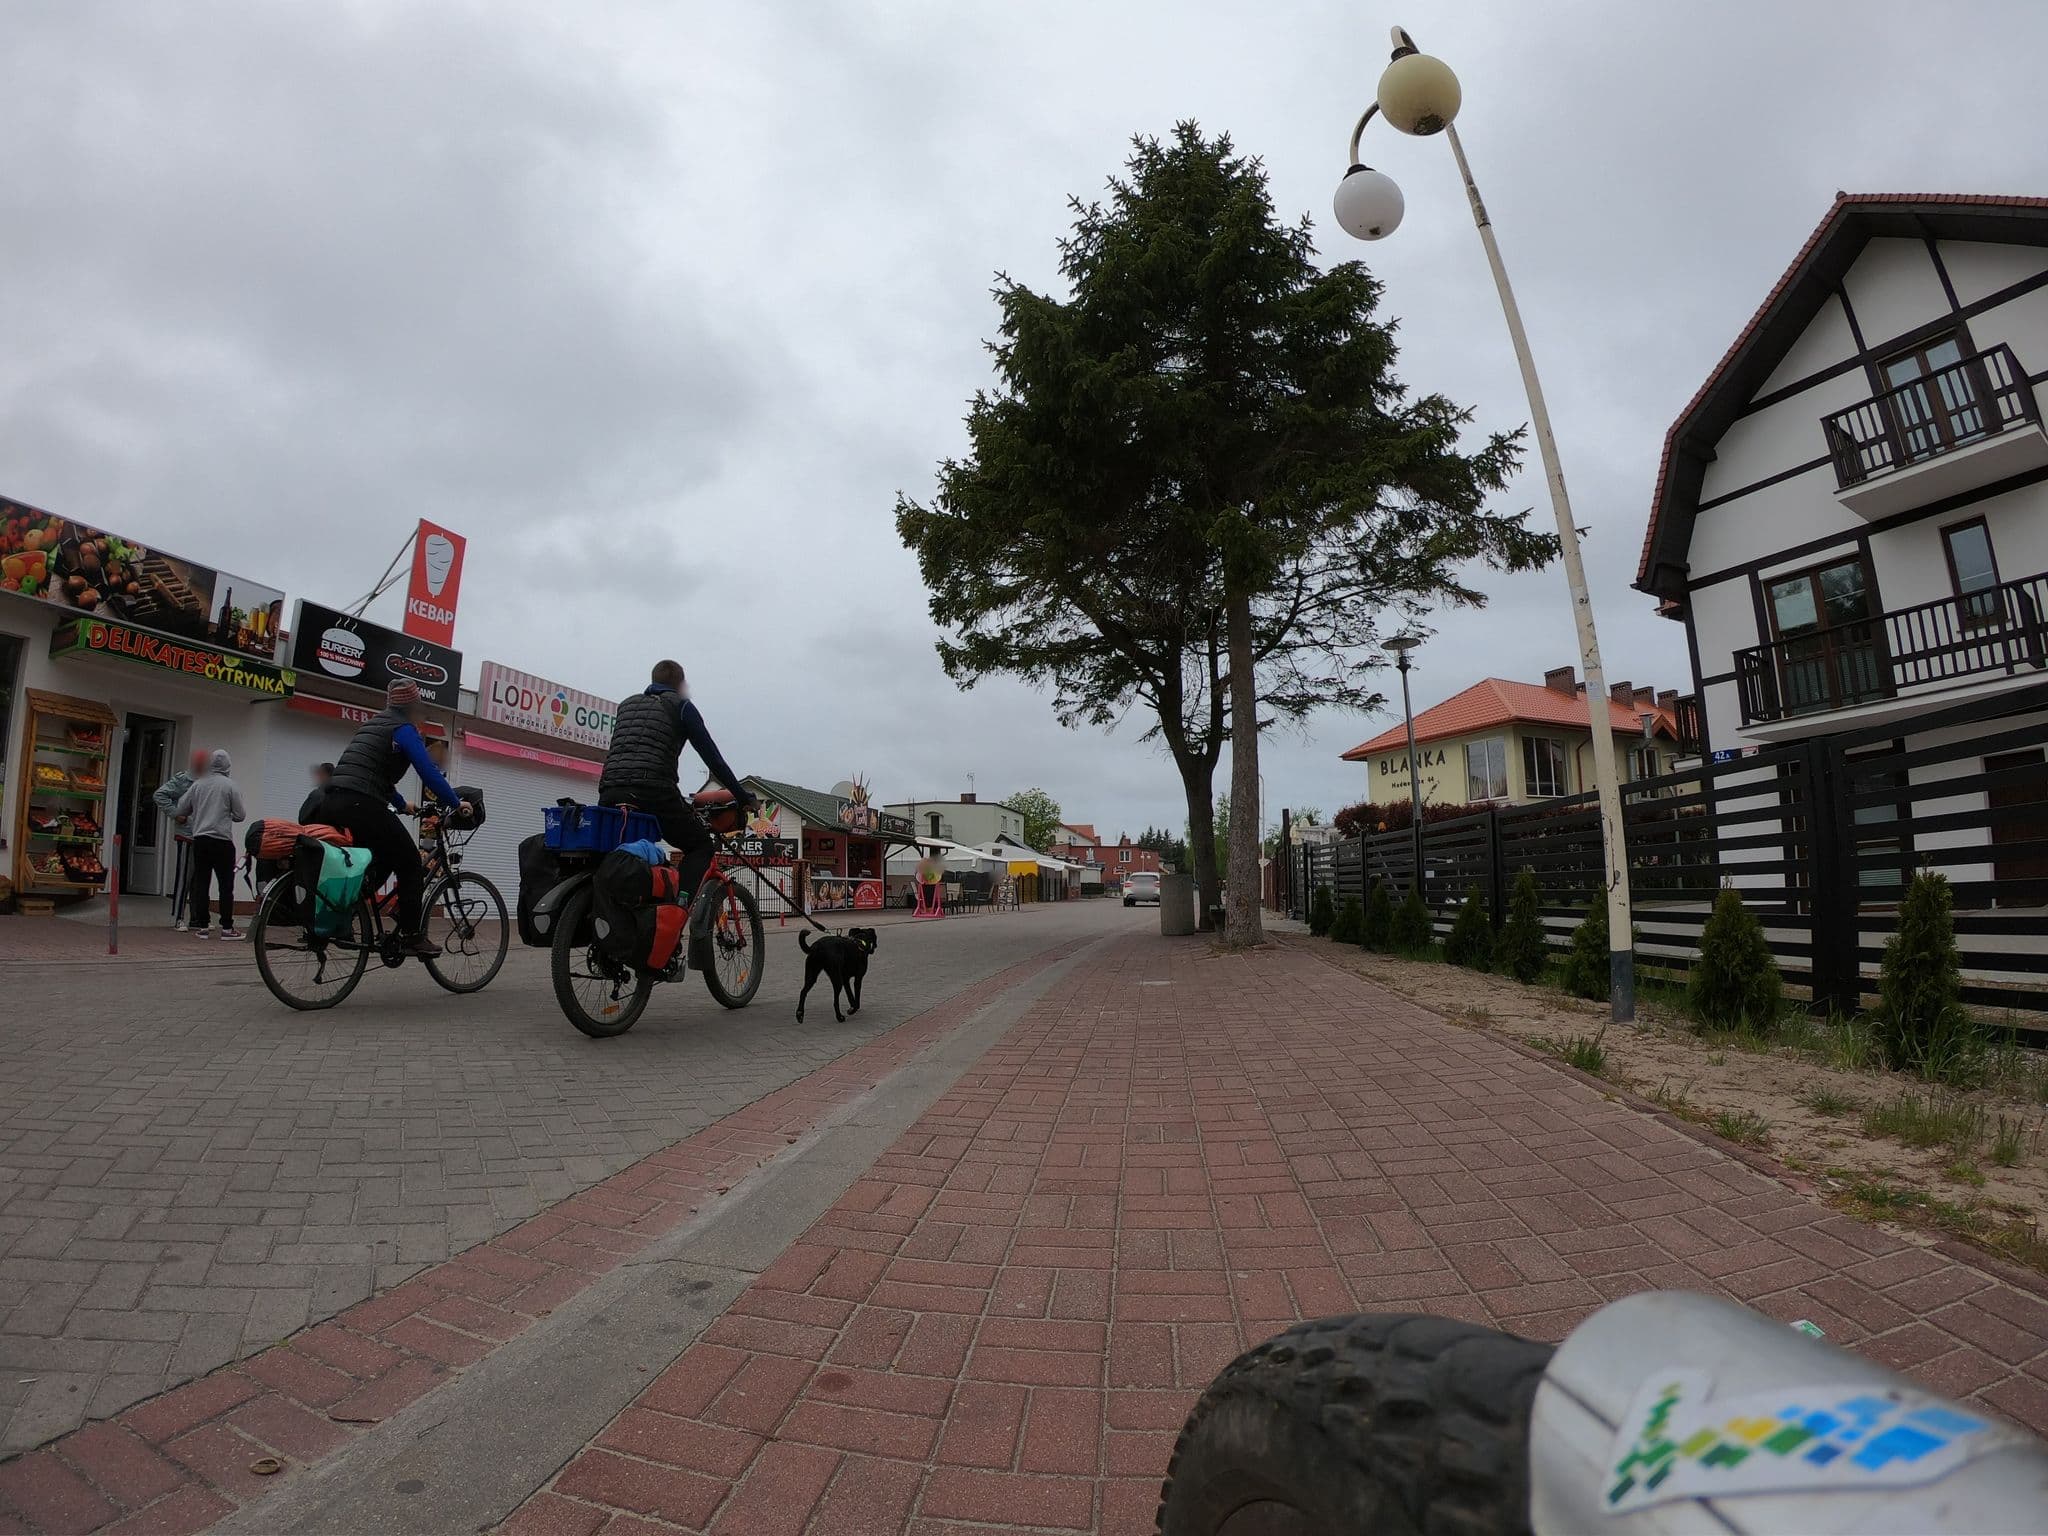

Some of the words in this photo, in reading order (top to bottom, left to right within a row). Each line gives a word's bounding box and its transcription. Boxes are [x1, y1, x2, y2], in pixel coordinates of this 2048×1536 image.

[408, 597, 454, 625] KEBAP
[89, 624, 222, 673] DELIKATESY
[321, 640, 364, 658] BURGERY
[204, 662, 285, 694] CYTRYNKA
[492, 681, 546, 714] LODY
